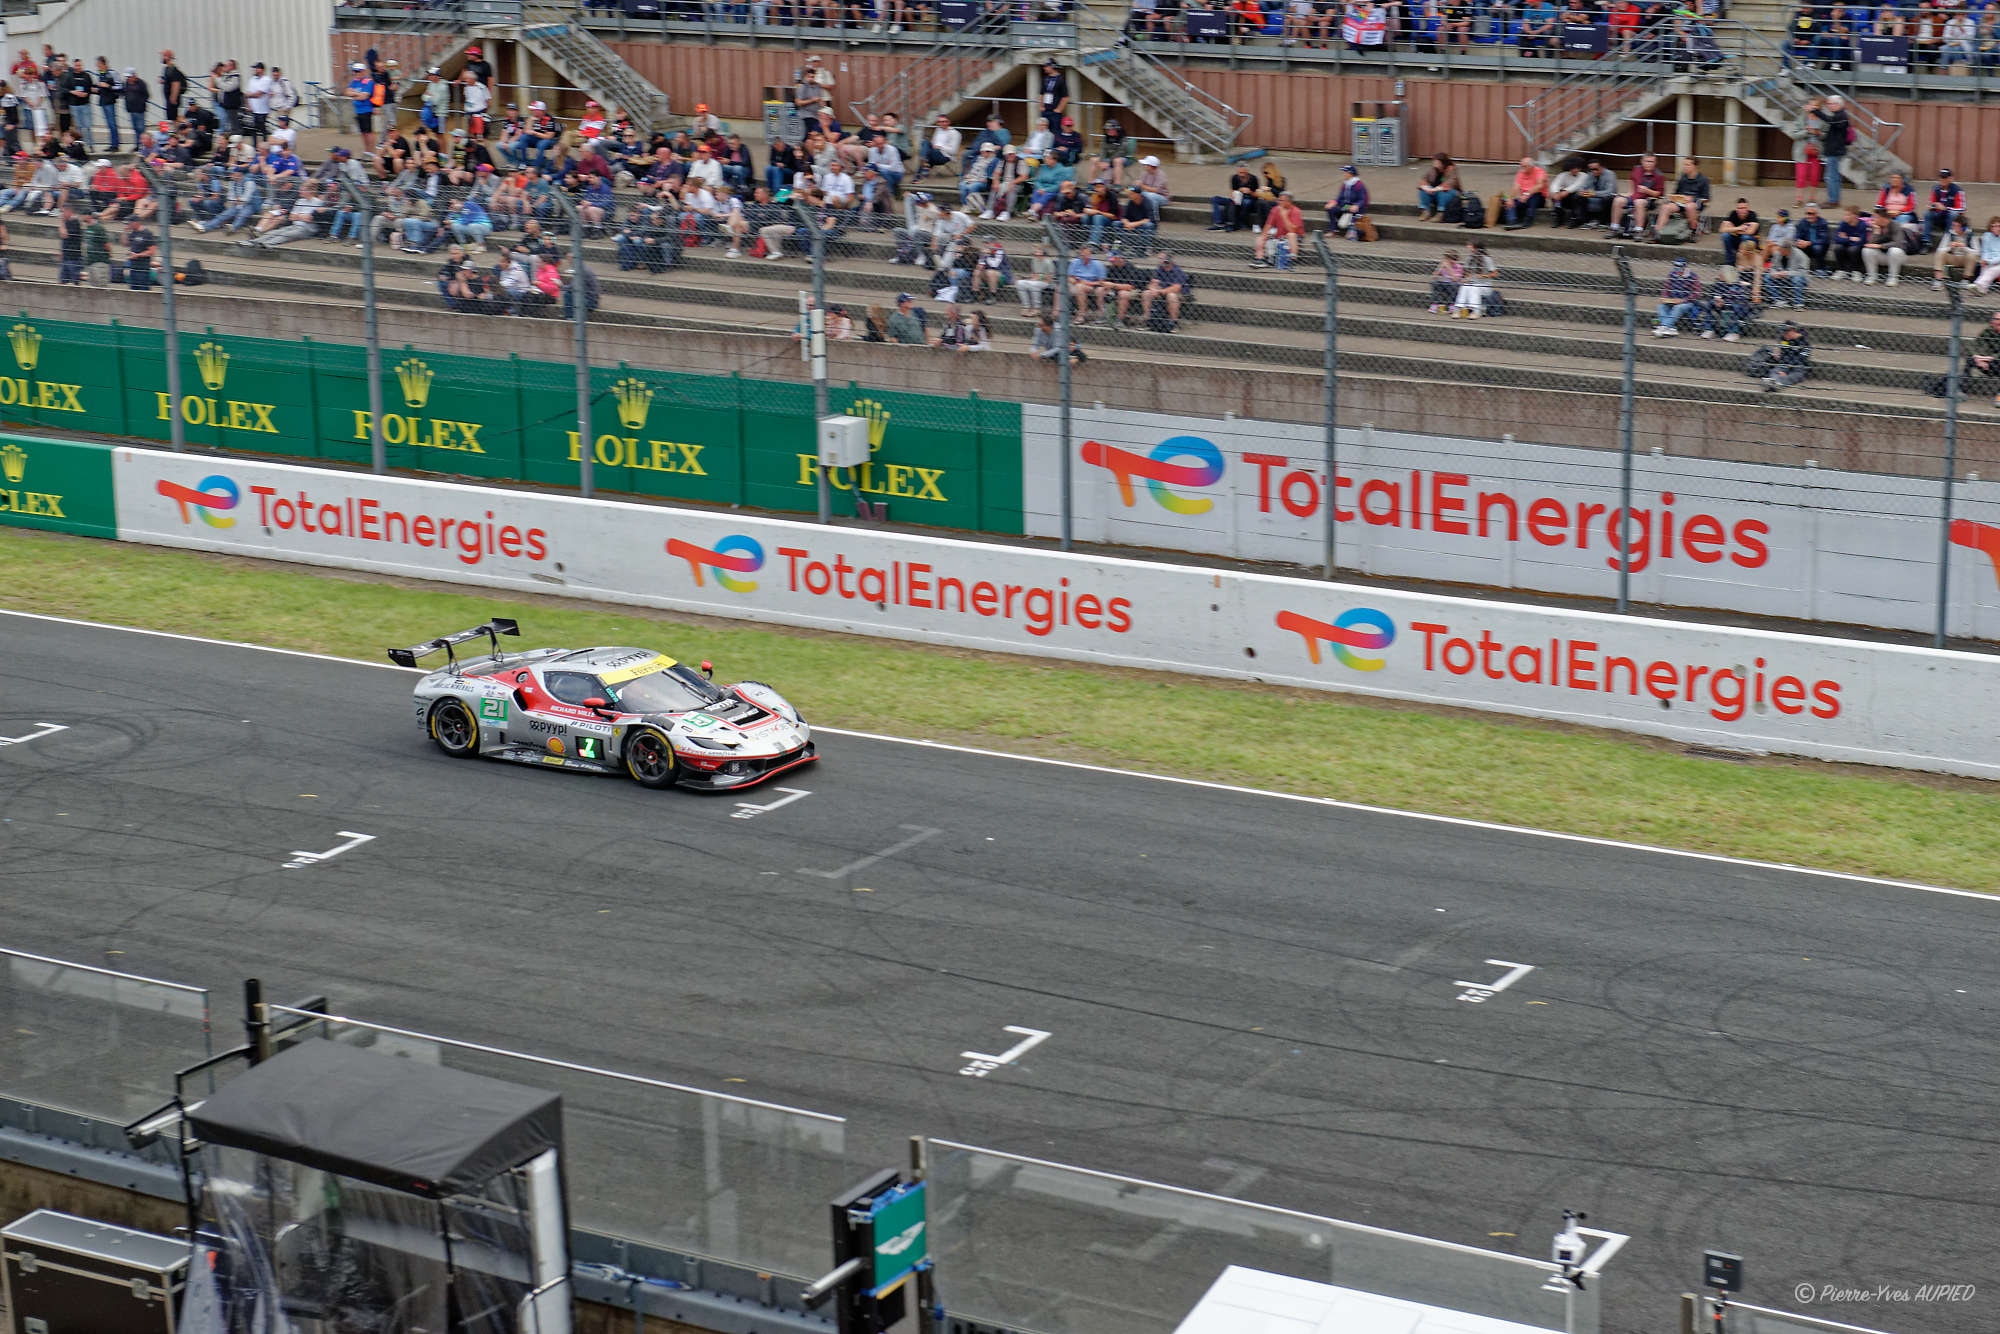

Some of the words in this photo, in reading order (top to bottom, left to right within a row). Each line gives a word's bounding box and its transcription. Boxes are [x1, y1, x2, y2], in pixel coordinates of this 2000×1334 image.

[250, 485, 547, 565] TotalEnergies
[777, 547, 1133, 636] TotalEnergies
[483, 699, 505, 719] 21
[1410, 622, 1842, 722] TotalEnergies
[579, 722, 611, 733] PILOTI
